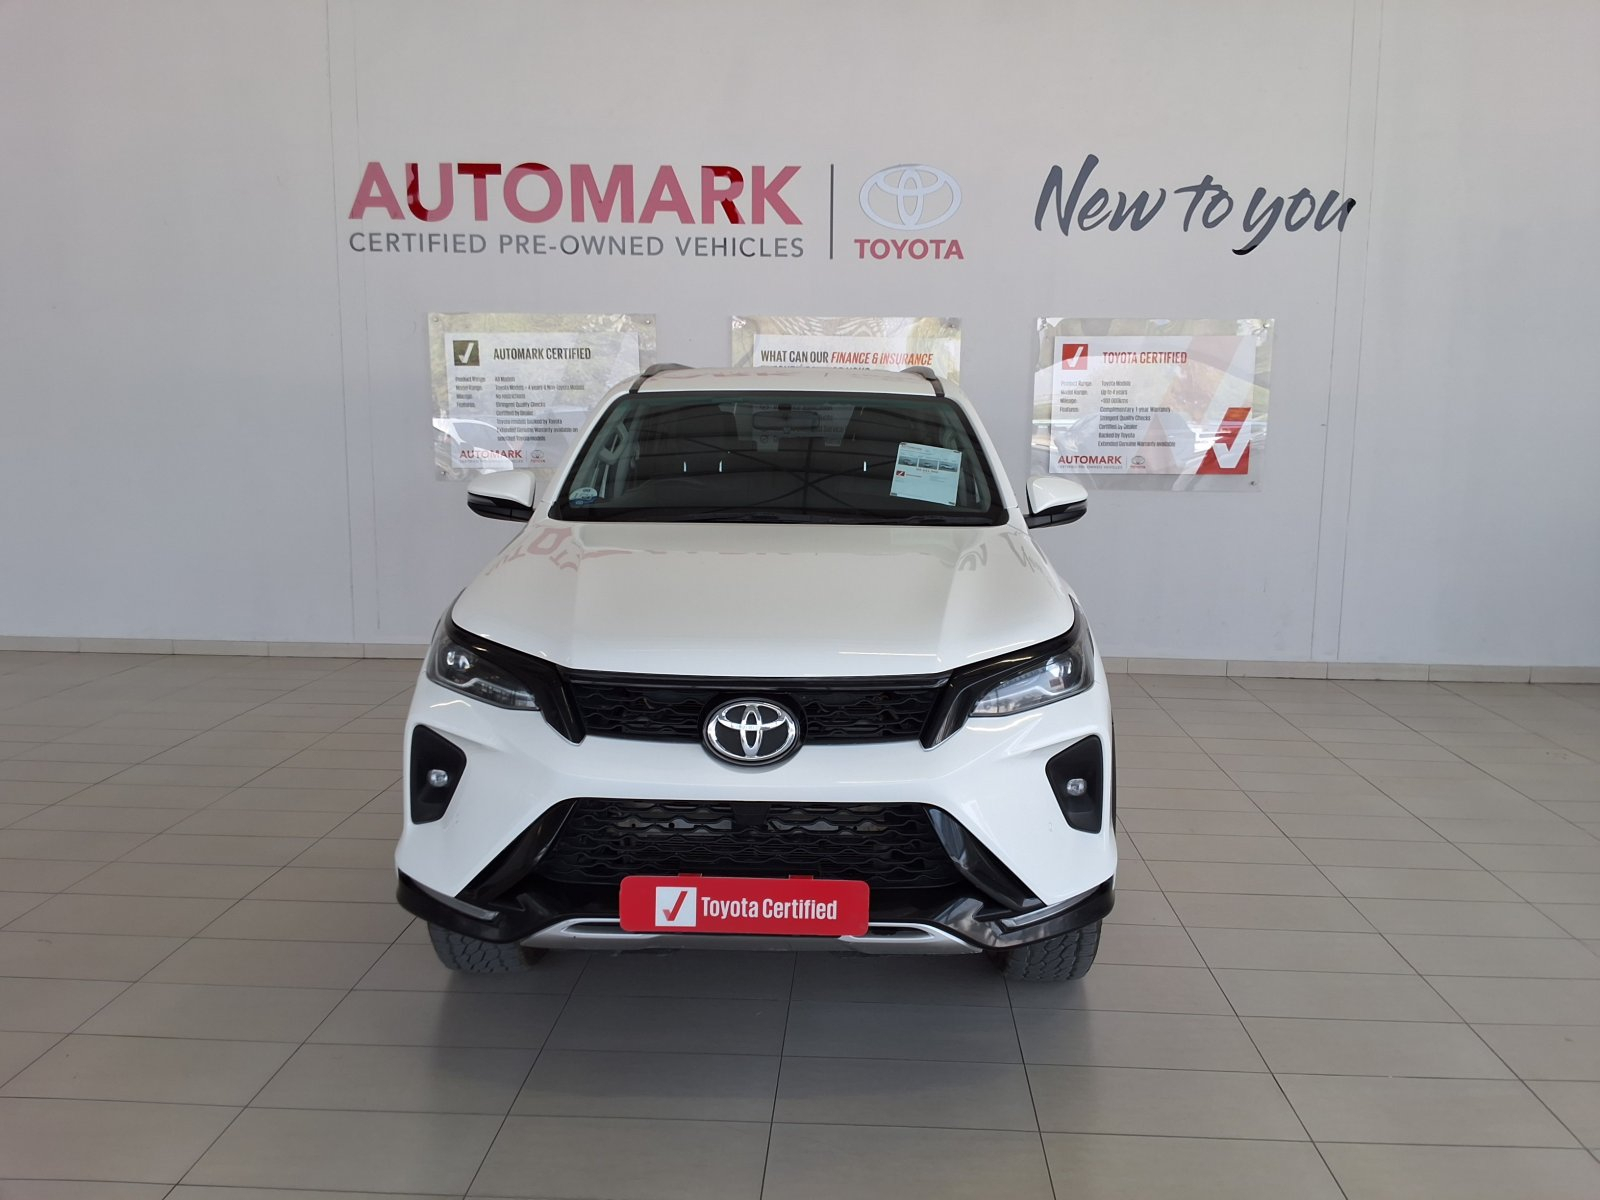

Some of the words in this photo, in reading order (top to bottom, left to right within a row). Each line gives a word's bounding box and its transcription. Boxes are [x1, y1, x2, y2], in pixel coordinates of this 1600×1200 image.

[347, 161, 804, 226] AUTOMARK
[1033, 153, 1168, 237] New
[1173, 174, 1235, 232] to
[1231, 186, 1357, 256] you
[348, 232, 488, 255] CERTIFIED
[498, 234, 665, 257] PRE-OWNED
[674, 236, 805, 259] VEHICLES
[853, 238, 965, 260] TOYOTA
[493, 347, 545, 361] AUTOMARK
[545, 347, 592, 361] CERTIFIED
[760, 350, 787, 363] WHAT
[788, 350, 808, 364] CAN
[810, 351, 829, 364] OUR
[830, 352, 871, 365] FINANCE
[871, 352, 878, 365] &
[879, 352, 934, 366] INSURANCE
[1102, 351, 1138, 364] TOYOTA
[1139, 351, 1188, 364] CERTIFIED
[459, 449, 523, 459] AUTOMARK
[1057, 455, 1122, 465] AUTOMARK
[701, 896, 759, 920] Toyota
[762, 898, 838, 921] Certified
